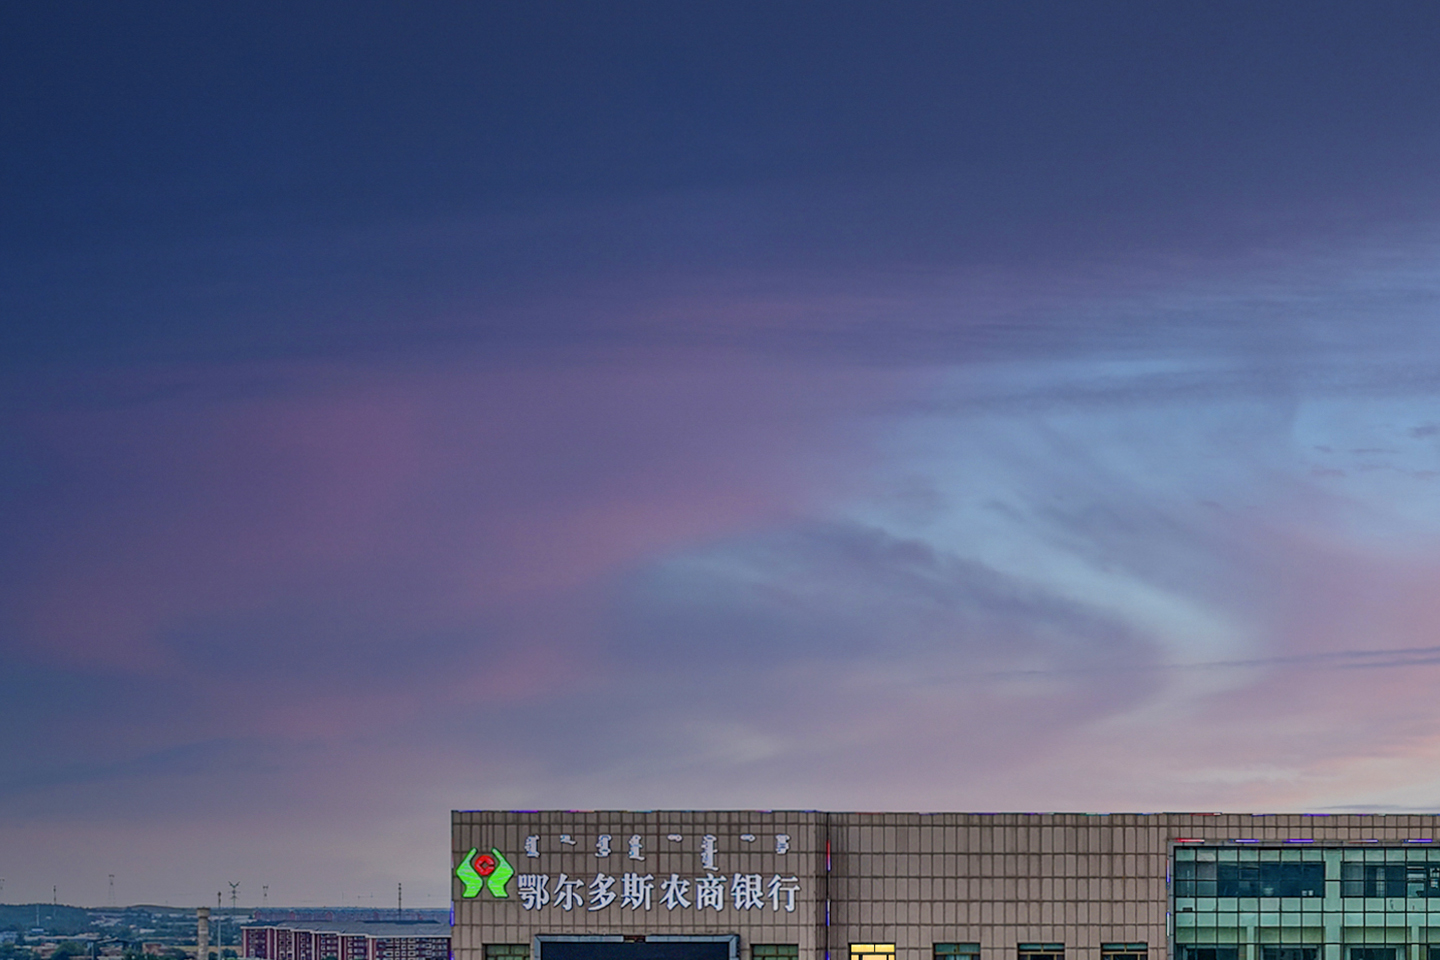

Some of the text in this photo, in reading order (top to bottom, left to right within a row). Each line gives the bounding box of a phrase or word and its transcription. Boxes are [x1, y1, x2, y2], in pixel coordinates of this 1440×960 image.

[517, 873, 801, 912] 鄂尔多斯农商银行
